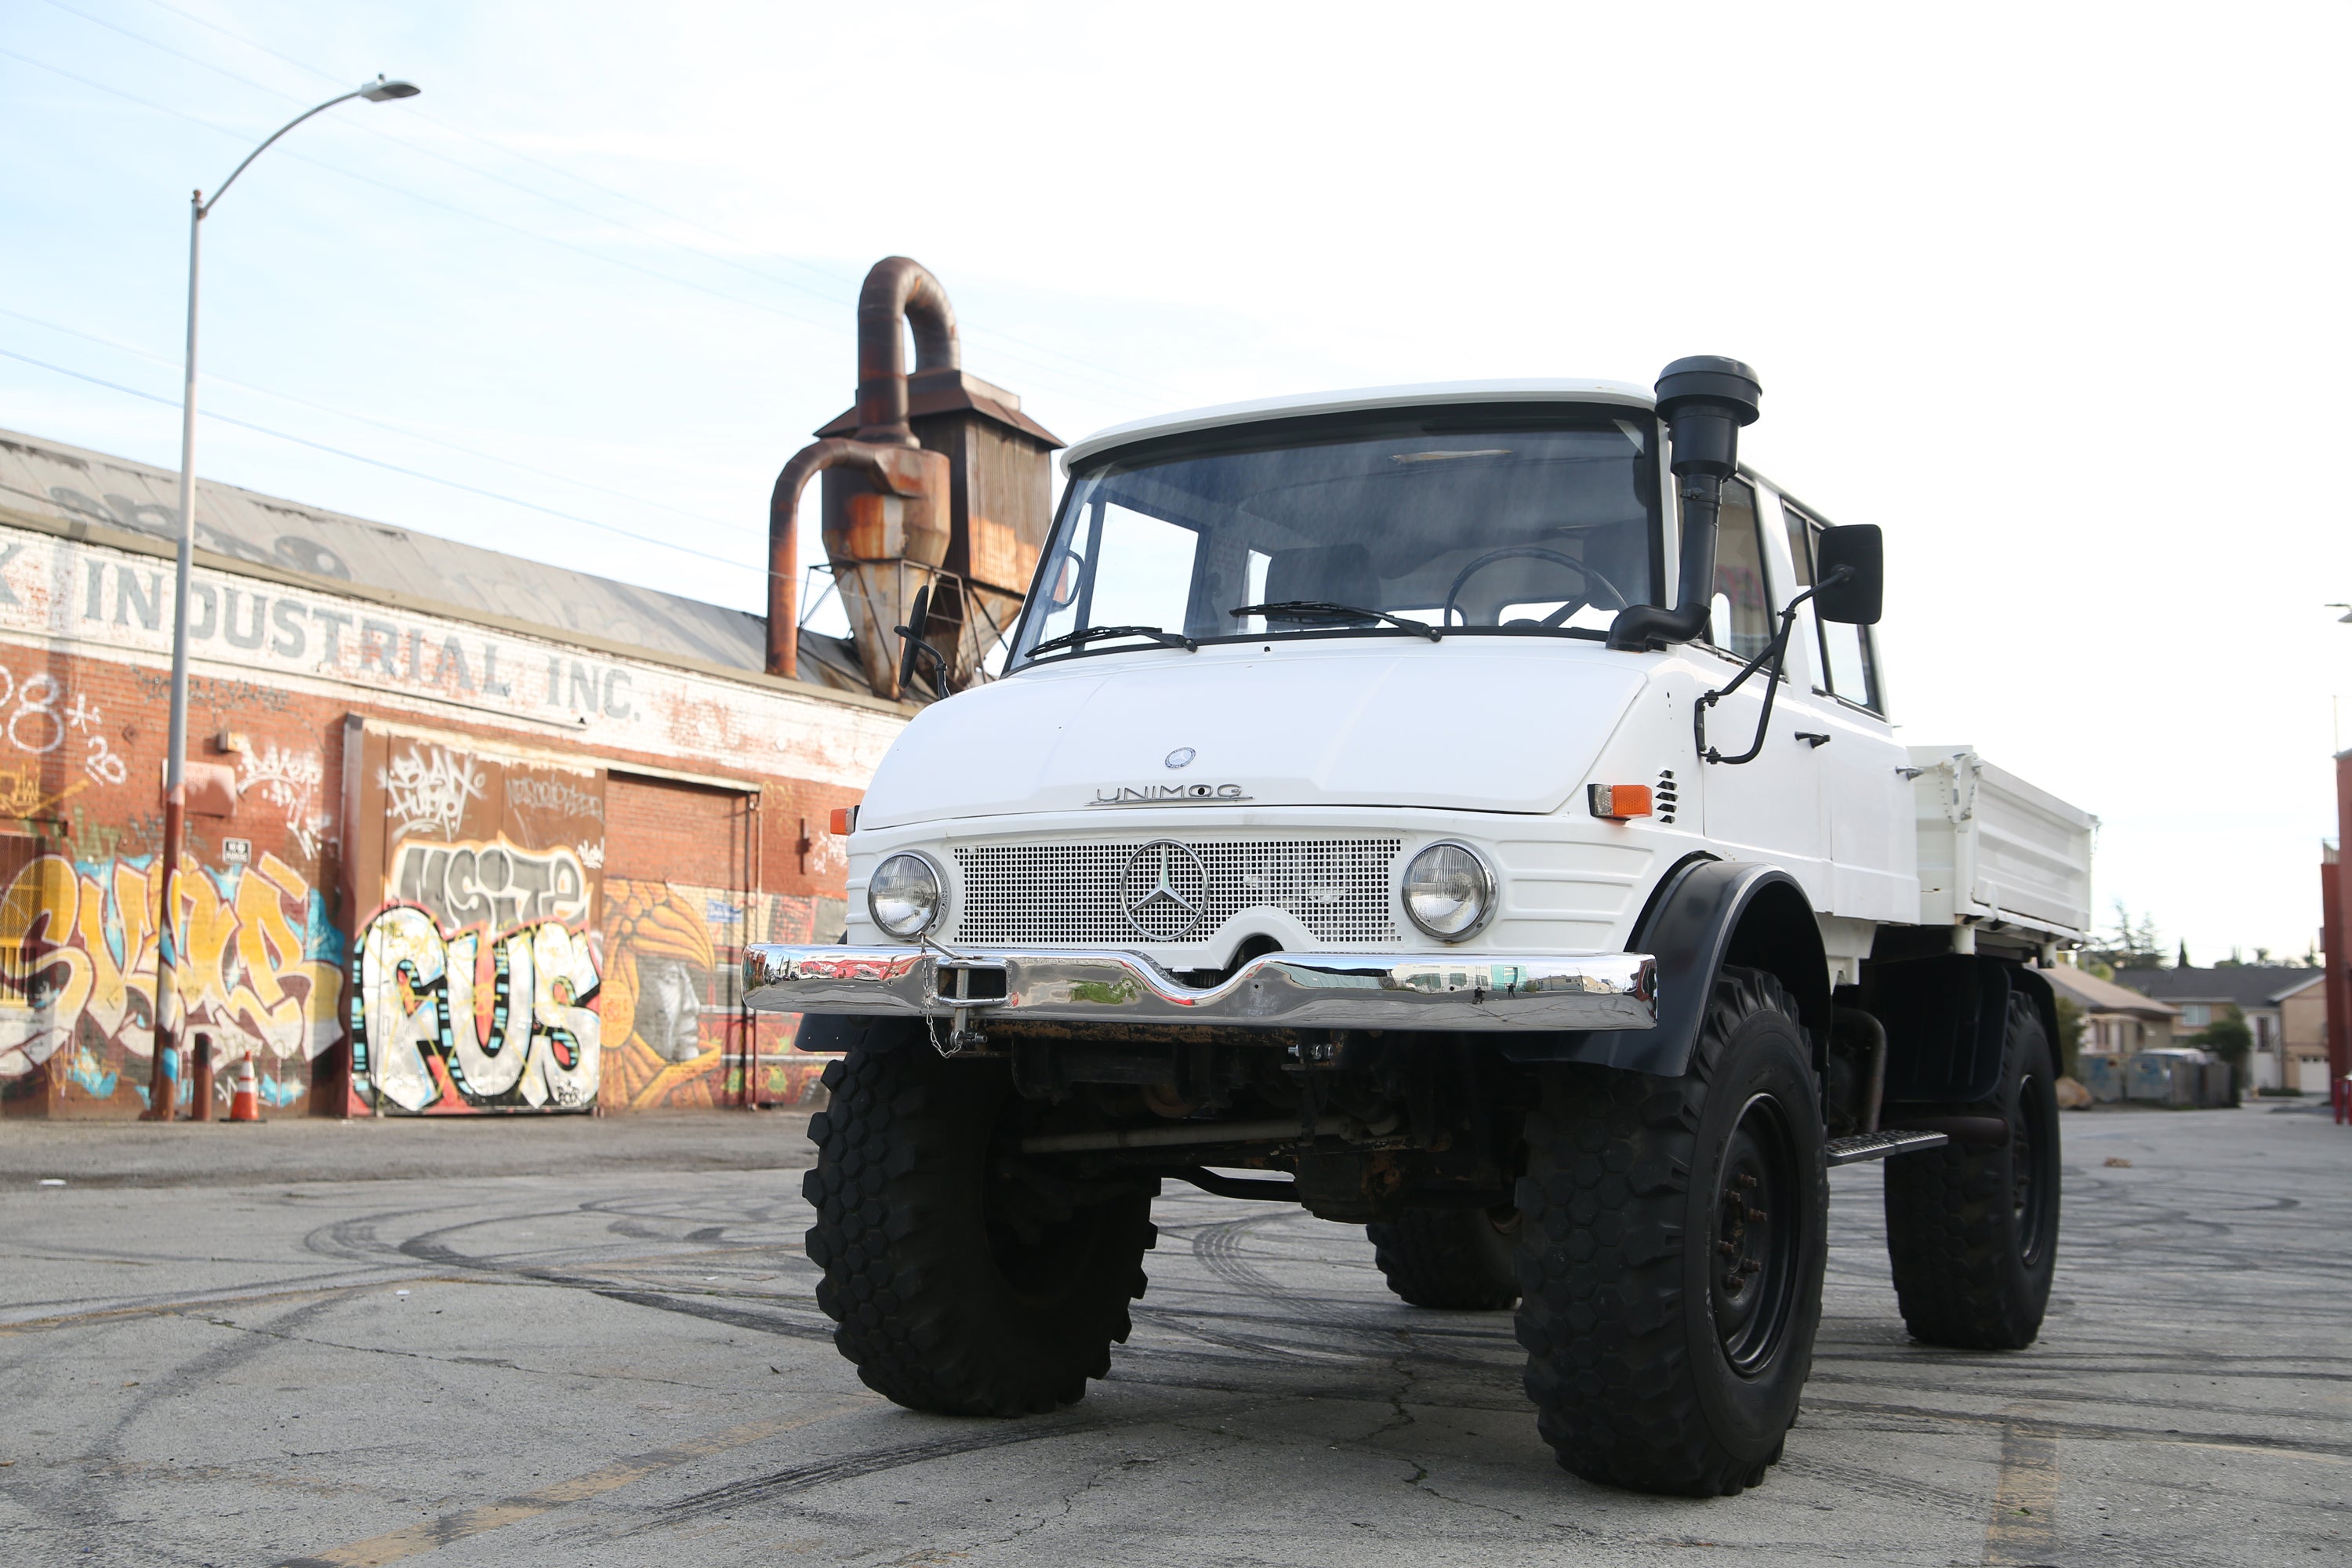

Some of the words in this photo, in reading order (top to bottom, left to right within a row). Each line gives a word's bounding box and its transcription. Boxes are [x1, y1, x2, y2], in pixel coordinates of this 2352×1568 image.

[82, 557, 511, 698] INDUSTRIAL
[546, 657, 641, 722] INC.
[1096, 783, 1243, 801] UNIMOG
